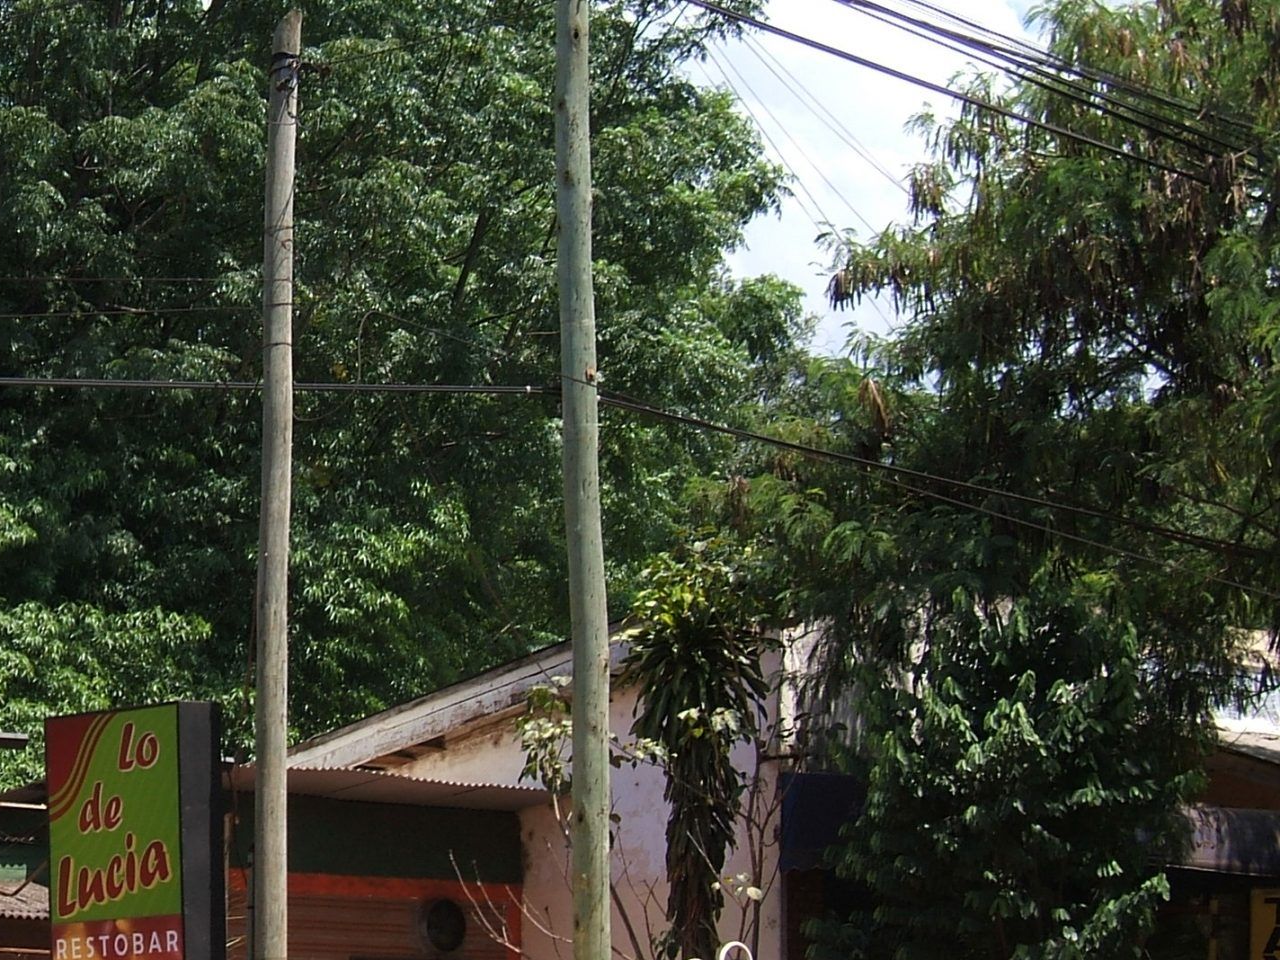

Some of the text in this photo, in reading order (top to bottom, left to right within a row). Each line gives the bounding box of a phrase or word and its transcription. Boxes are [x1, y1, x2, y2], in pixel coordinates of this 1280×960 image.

[118, 721, 161, 773] Lo
[78, 780, 123, 835] de
[56, 930, 179, 960] RESTOBAR
